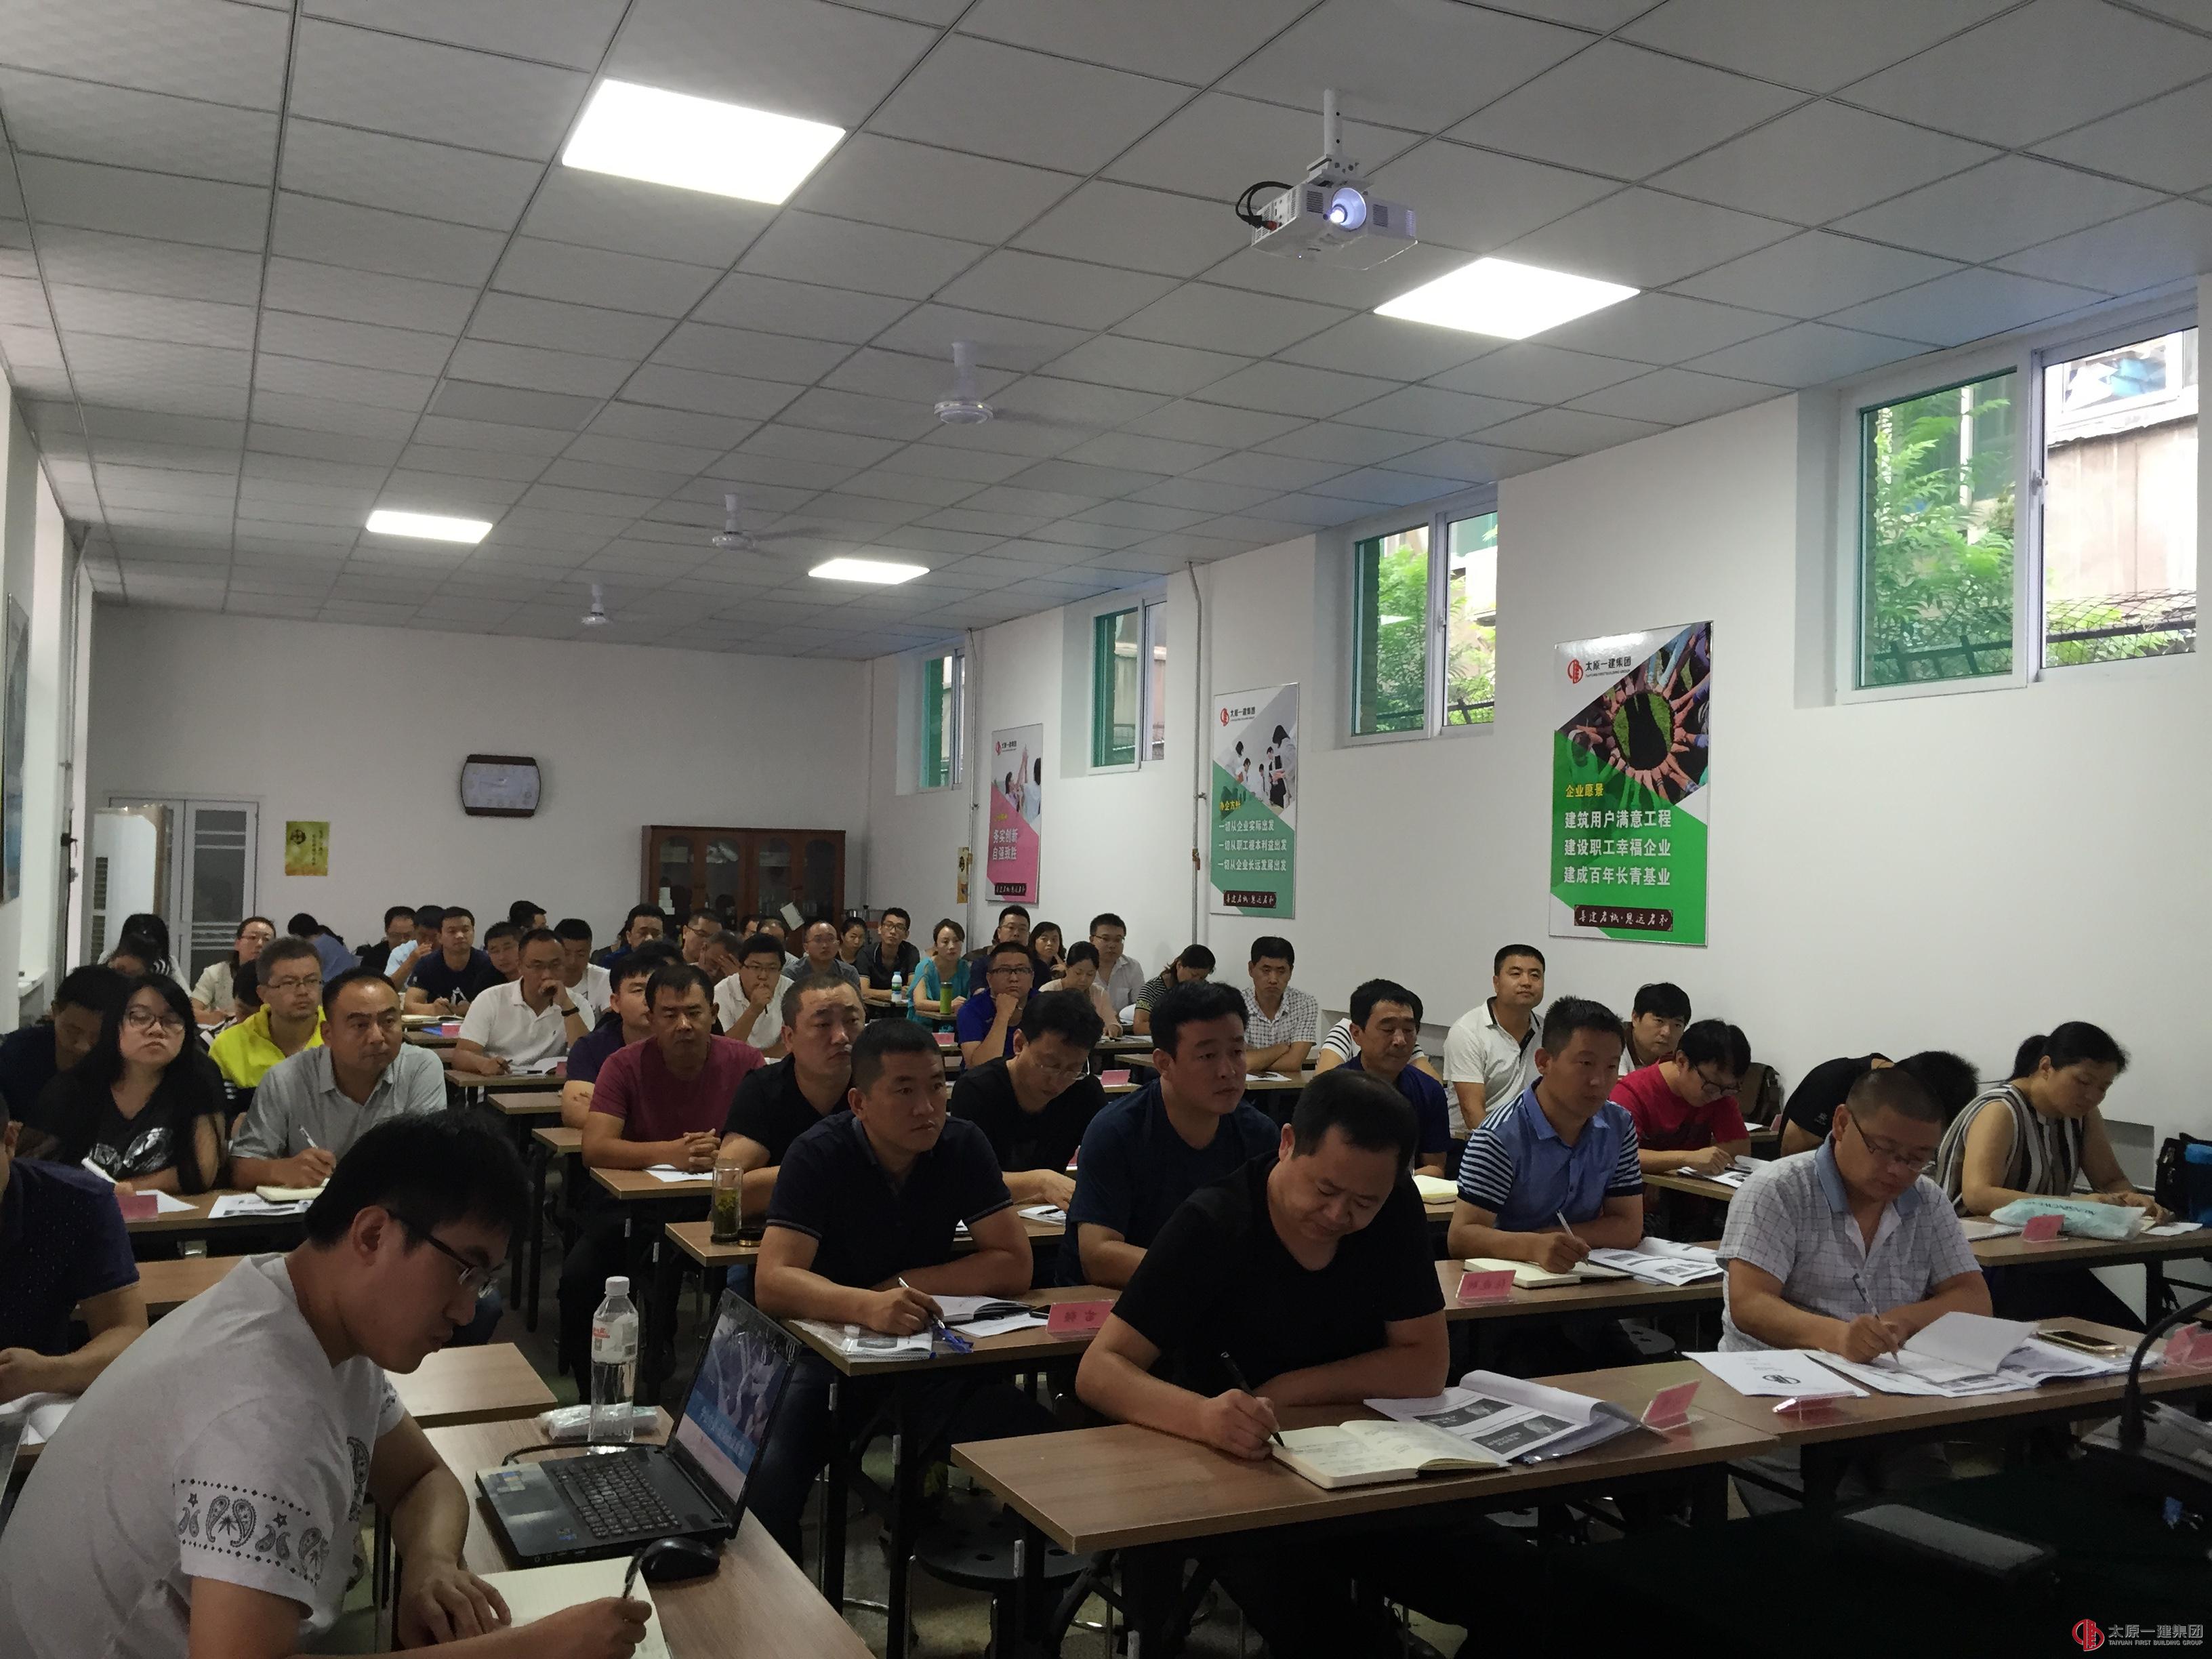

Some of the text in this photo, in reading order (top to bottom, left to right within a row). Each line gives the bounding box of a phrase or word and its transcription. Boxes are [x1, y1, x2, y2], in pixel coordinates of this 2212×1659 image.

[1585, 656, 1632, 672] 太原一建集团
[1565, 783, 1604, 798] 企业愿景
[1218, 819, 1275, 832] 一切从企业实际出发
[1564, 809, 1672, 829] 建筑用户满意工程
[1218, 839, 1287, 852] 一切从职工根本利益出发
[1564, 838, 1671, 857] 建设职工幸福企业
[1217, 859, 1287, 872] 一切从企业长远发展出发
[1563, 866, 1671, 886] 建成百年长青基业
